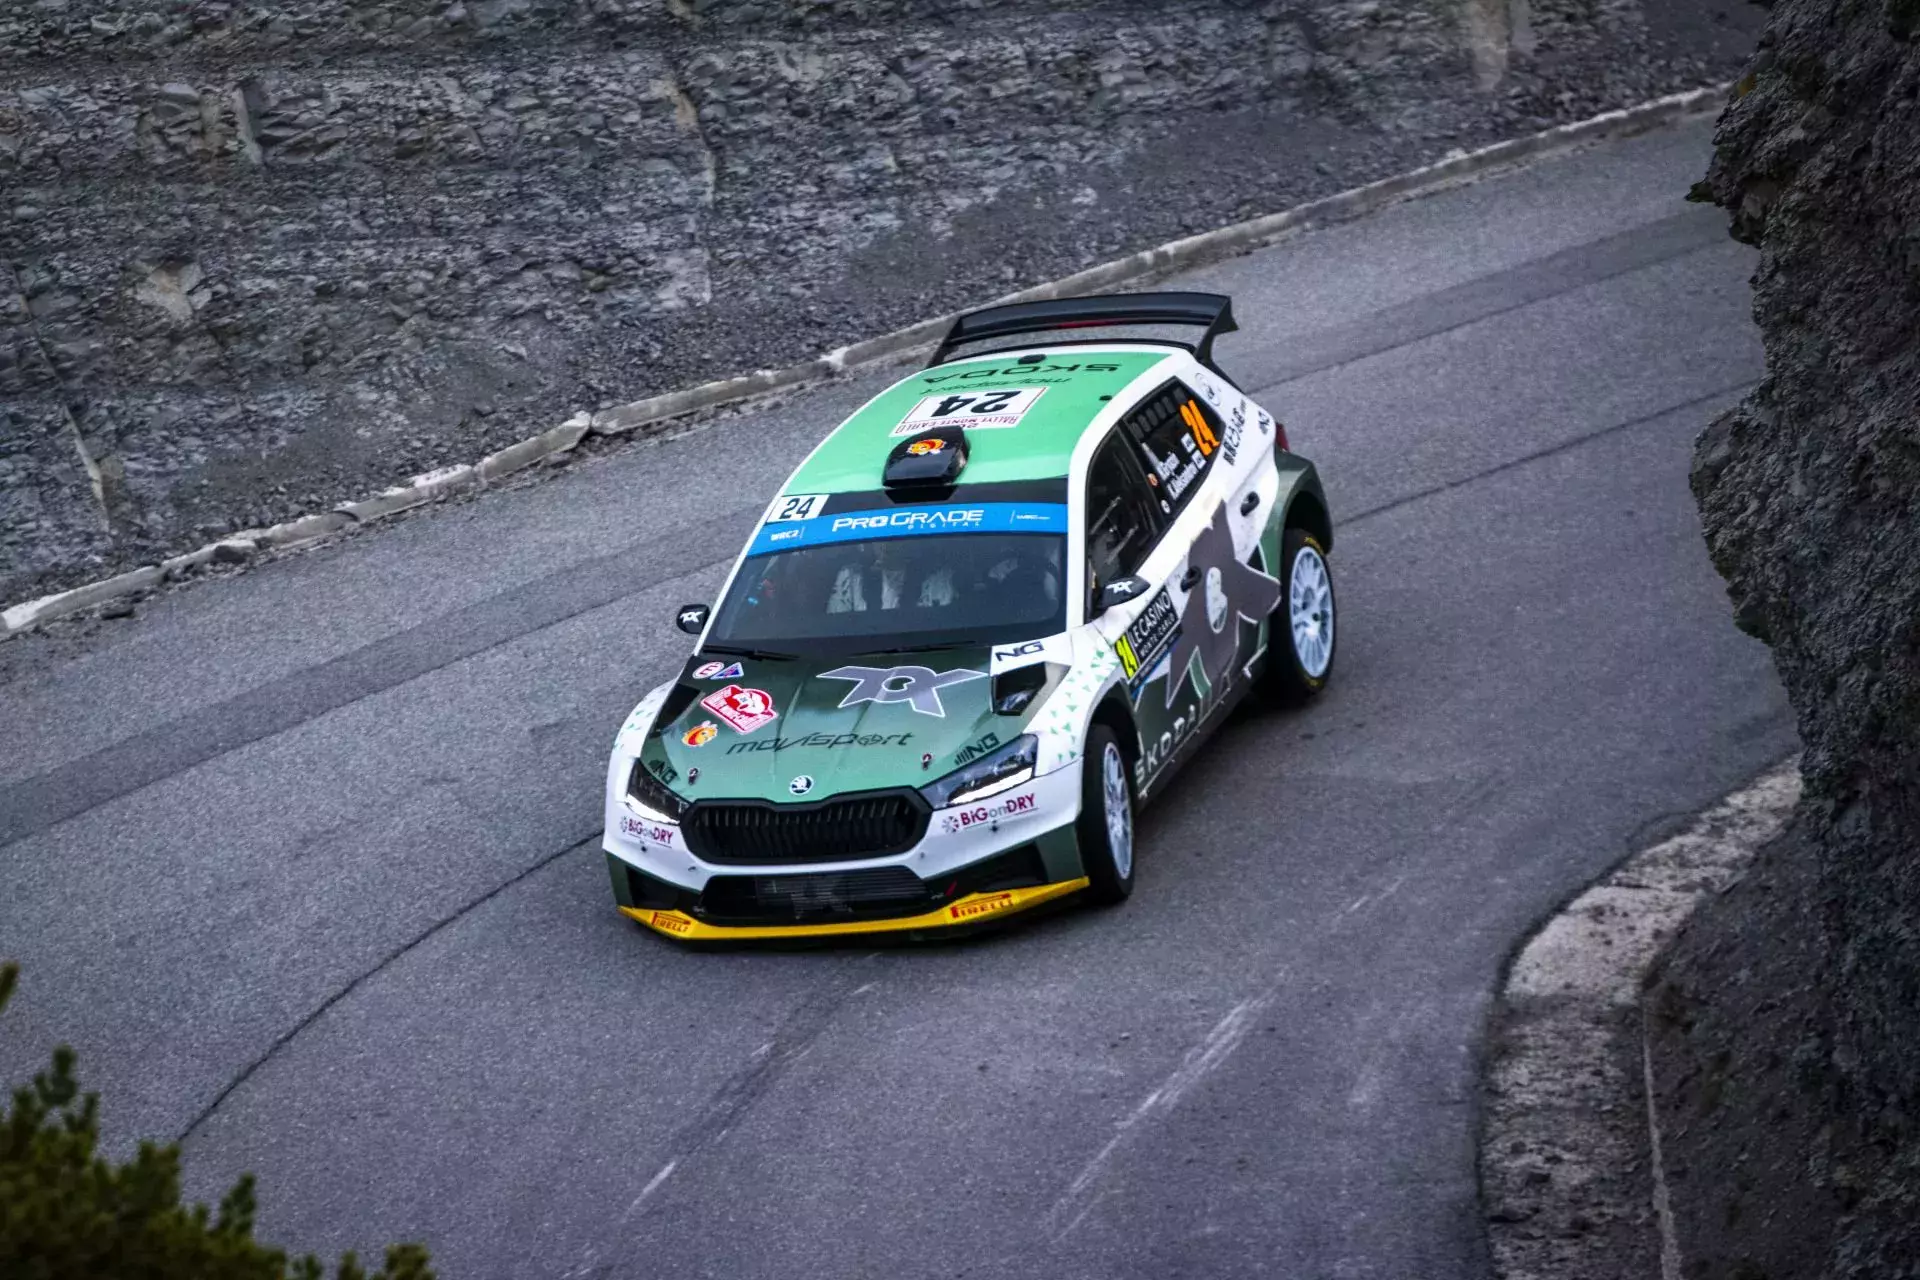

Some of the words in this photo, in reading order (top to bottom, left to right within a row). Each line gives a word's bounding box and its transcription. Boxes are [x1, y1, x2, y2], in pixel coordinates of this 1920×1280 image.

[930, 390, 1022, 418] 24
[1179, 399, 1220, 456] 24
[779, 496, 816, 519] 24
[907, 521, 980, 531] DIGITAL
[1139, 591, 1171, 637] CASINO
[994, 640, 1046, 662] NG
[951, 892, 1014, 919] PIRELLI
[652, 911, 691, 933] PIRELLI
